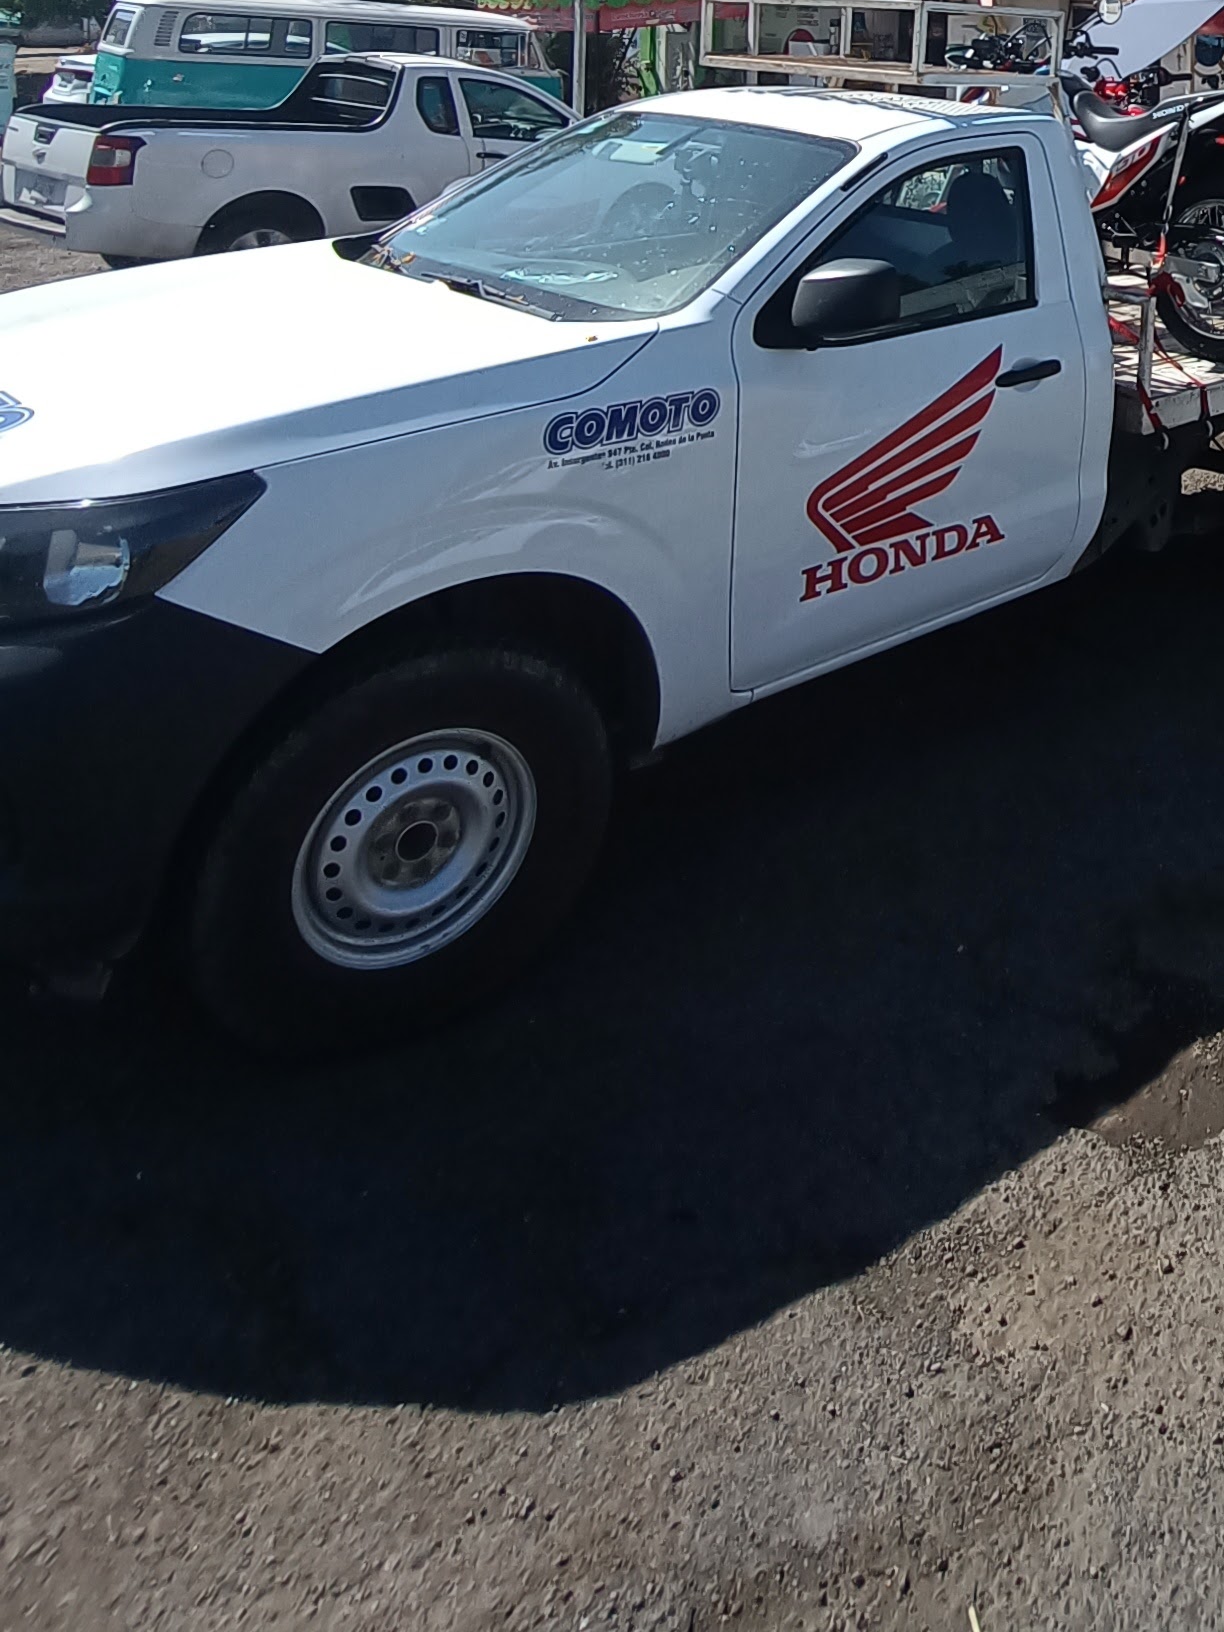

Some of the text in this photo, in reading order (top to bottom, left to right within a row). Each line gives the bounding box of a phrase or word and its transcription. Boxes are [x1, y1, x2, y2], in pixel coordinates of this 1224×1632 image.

[1152, 103, 1186, 120] HOND
[543, 388, 721, 456] COMOTO
[799, 515, 1005, 602] HONDA
